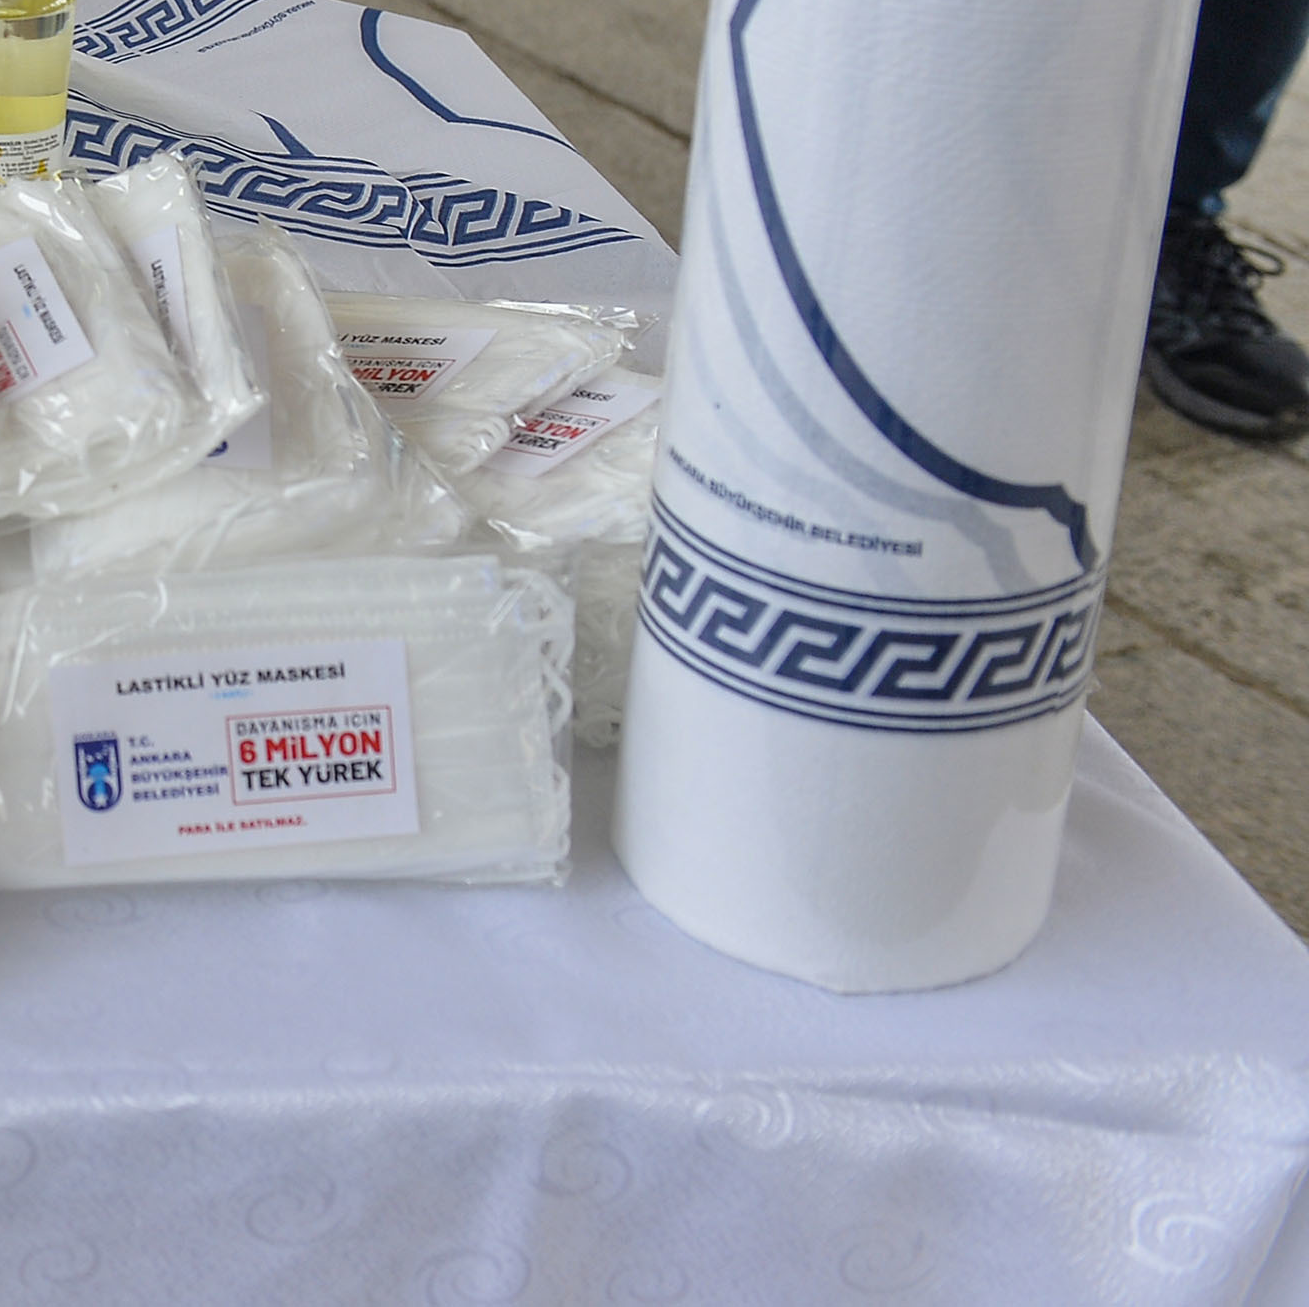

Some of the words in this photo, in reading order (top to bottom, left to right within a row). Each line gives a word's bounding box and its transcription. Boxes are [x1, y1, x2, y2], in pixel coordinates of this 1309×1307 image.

[351, 334, 380, 344] YÜZ
[380, 336, 448, 346] MASKESİ
[809, 524, 925, 559] BELEDİYESİ
[116, 672, 205, 696] LASTİKLİ
[210, 667, 251, 690] YÜZ
[256, 661, 347, 684] MASKESİ
[129, 751, 193, 766] ANKARA
[239, 739, 258, 765] 6
[130, 764, 229, 785] BÜYÜKŞEHİR
[242, 768, 292, 792] TEK
[132, 784, 221, 803] BELEDİYESİ
